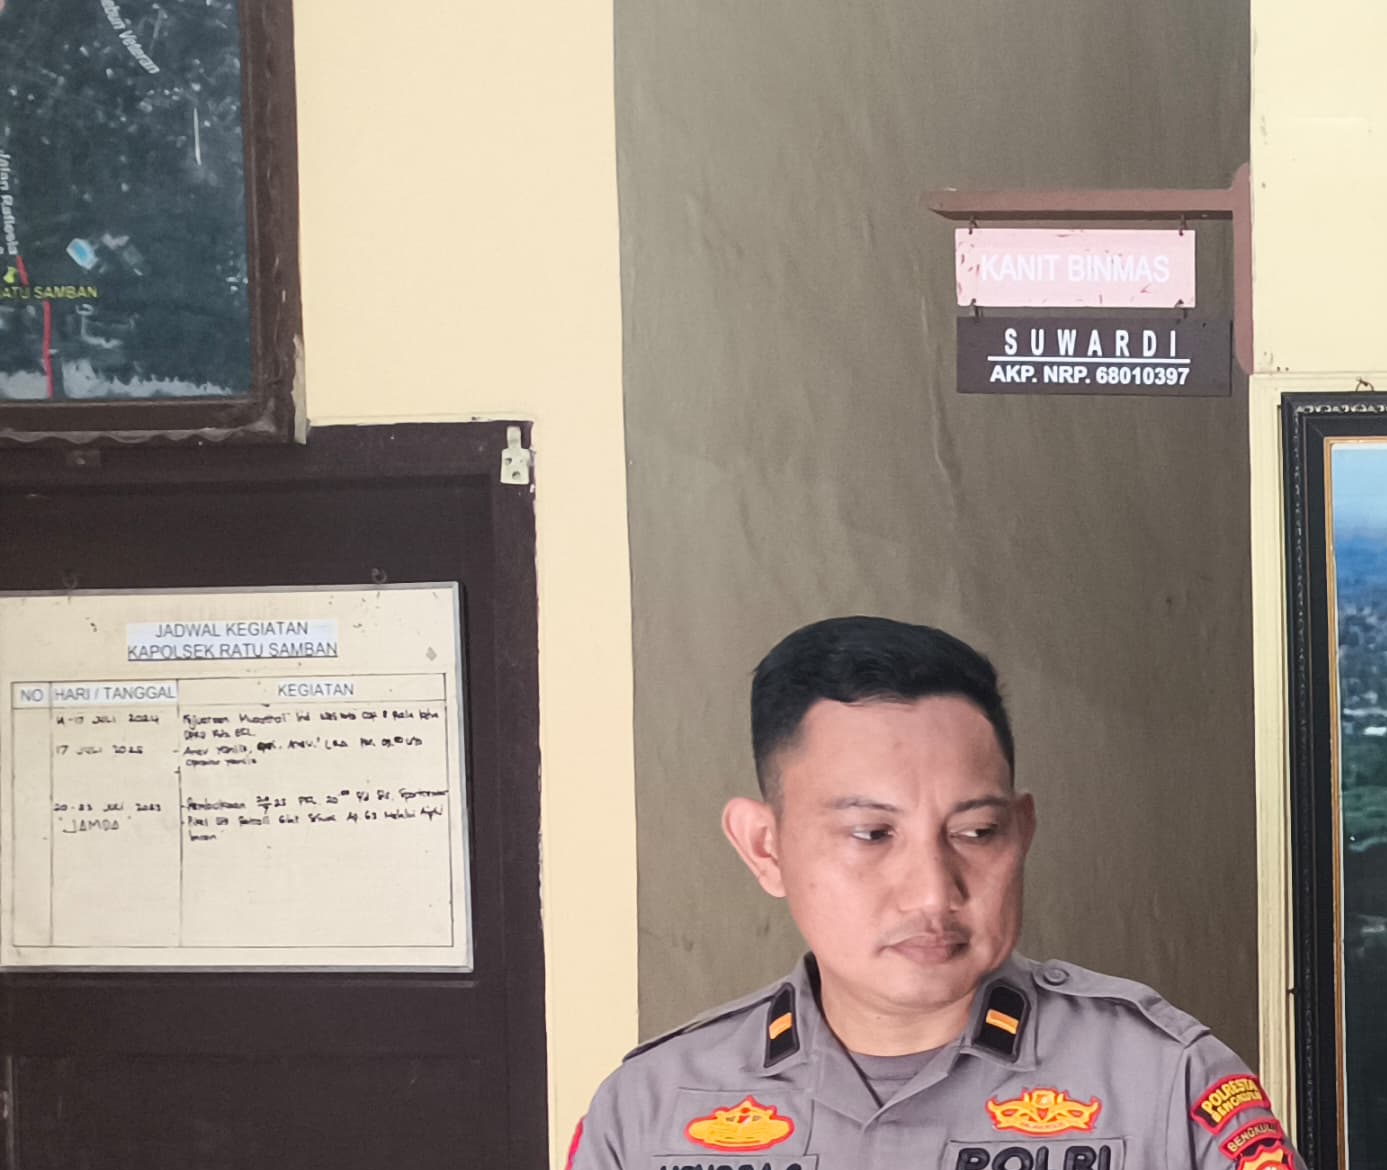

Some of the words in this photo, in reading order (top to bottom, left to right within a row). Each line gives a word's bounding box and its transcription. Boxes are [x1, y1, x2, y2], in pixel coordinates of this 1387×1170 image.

[118, 30, 160, 74] Veteran
[981, 254, 1061, 281] KANIT
[1068, 254, 1170, 283] BINMAS
[33, 286, 97, 299] SAMBAN
[990, 364, 1037, 383] AKP.
[1043, 365, 1091, 384] NRP.
[1096, 366, 1190, 385] 68010397
[155, 624, 221, 638] JADWAL
[226, 622, 309, 636] KEGIATAN
[128, 644, 215, 659] KAPOLSEK
[220, 643, 264, 657] RATU
[268, 641, 338, 657] SAMBAN
[21, 688, 43, 701] NO
[55, 687, 91, 700] HARI
[103, 686, 176, 700] TANGGAL
[277, 682, 354, 696] KEGIATAN
